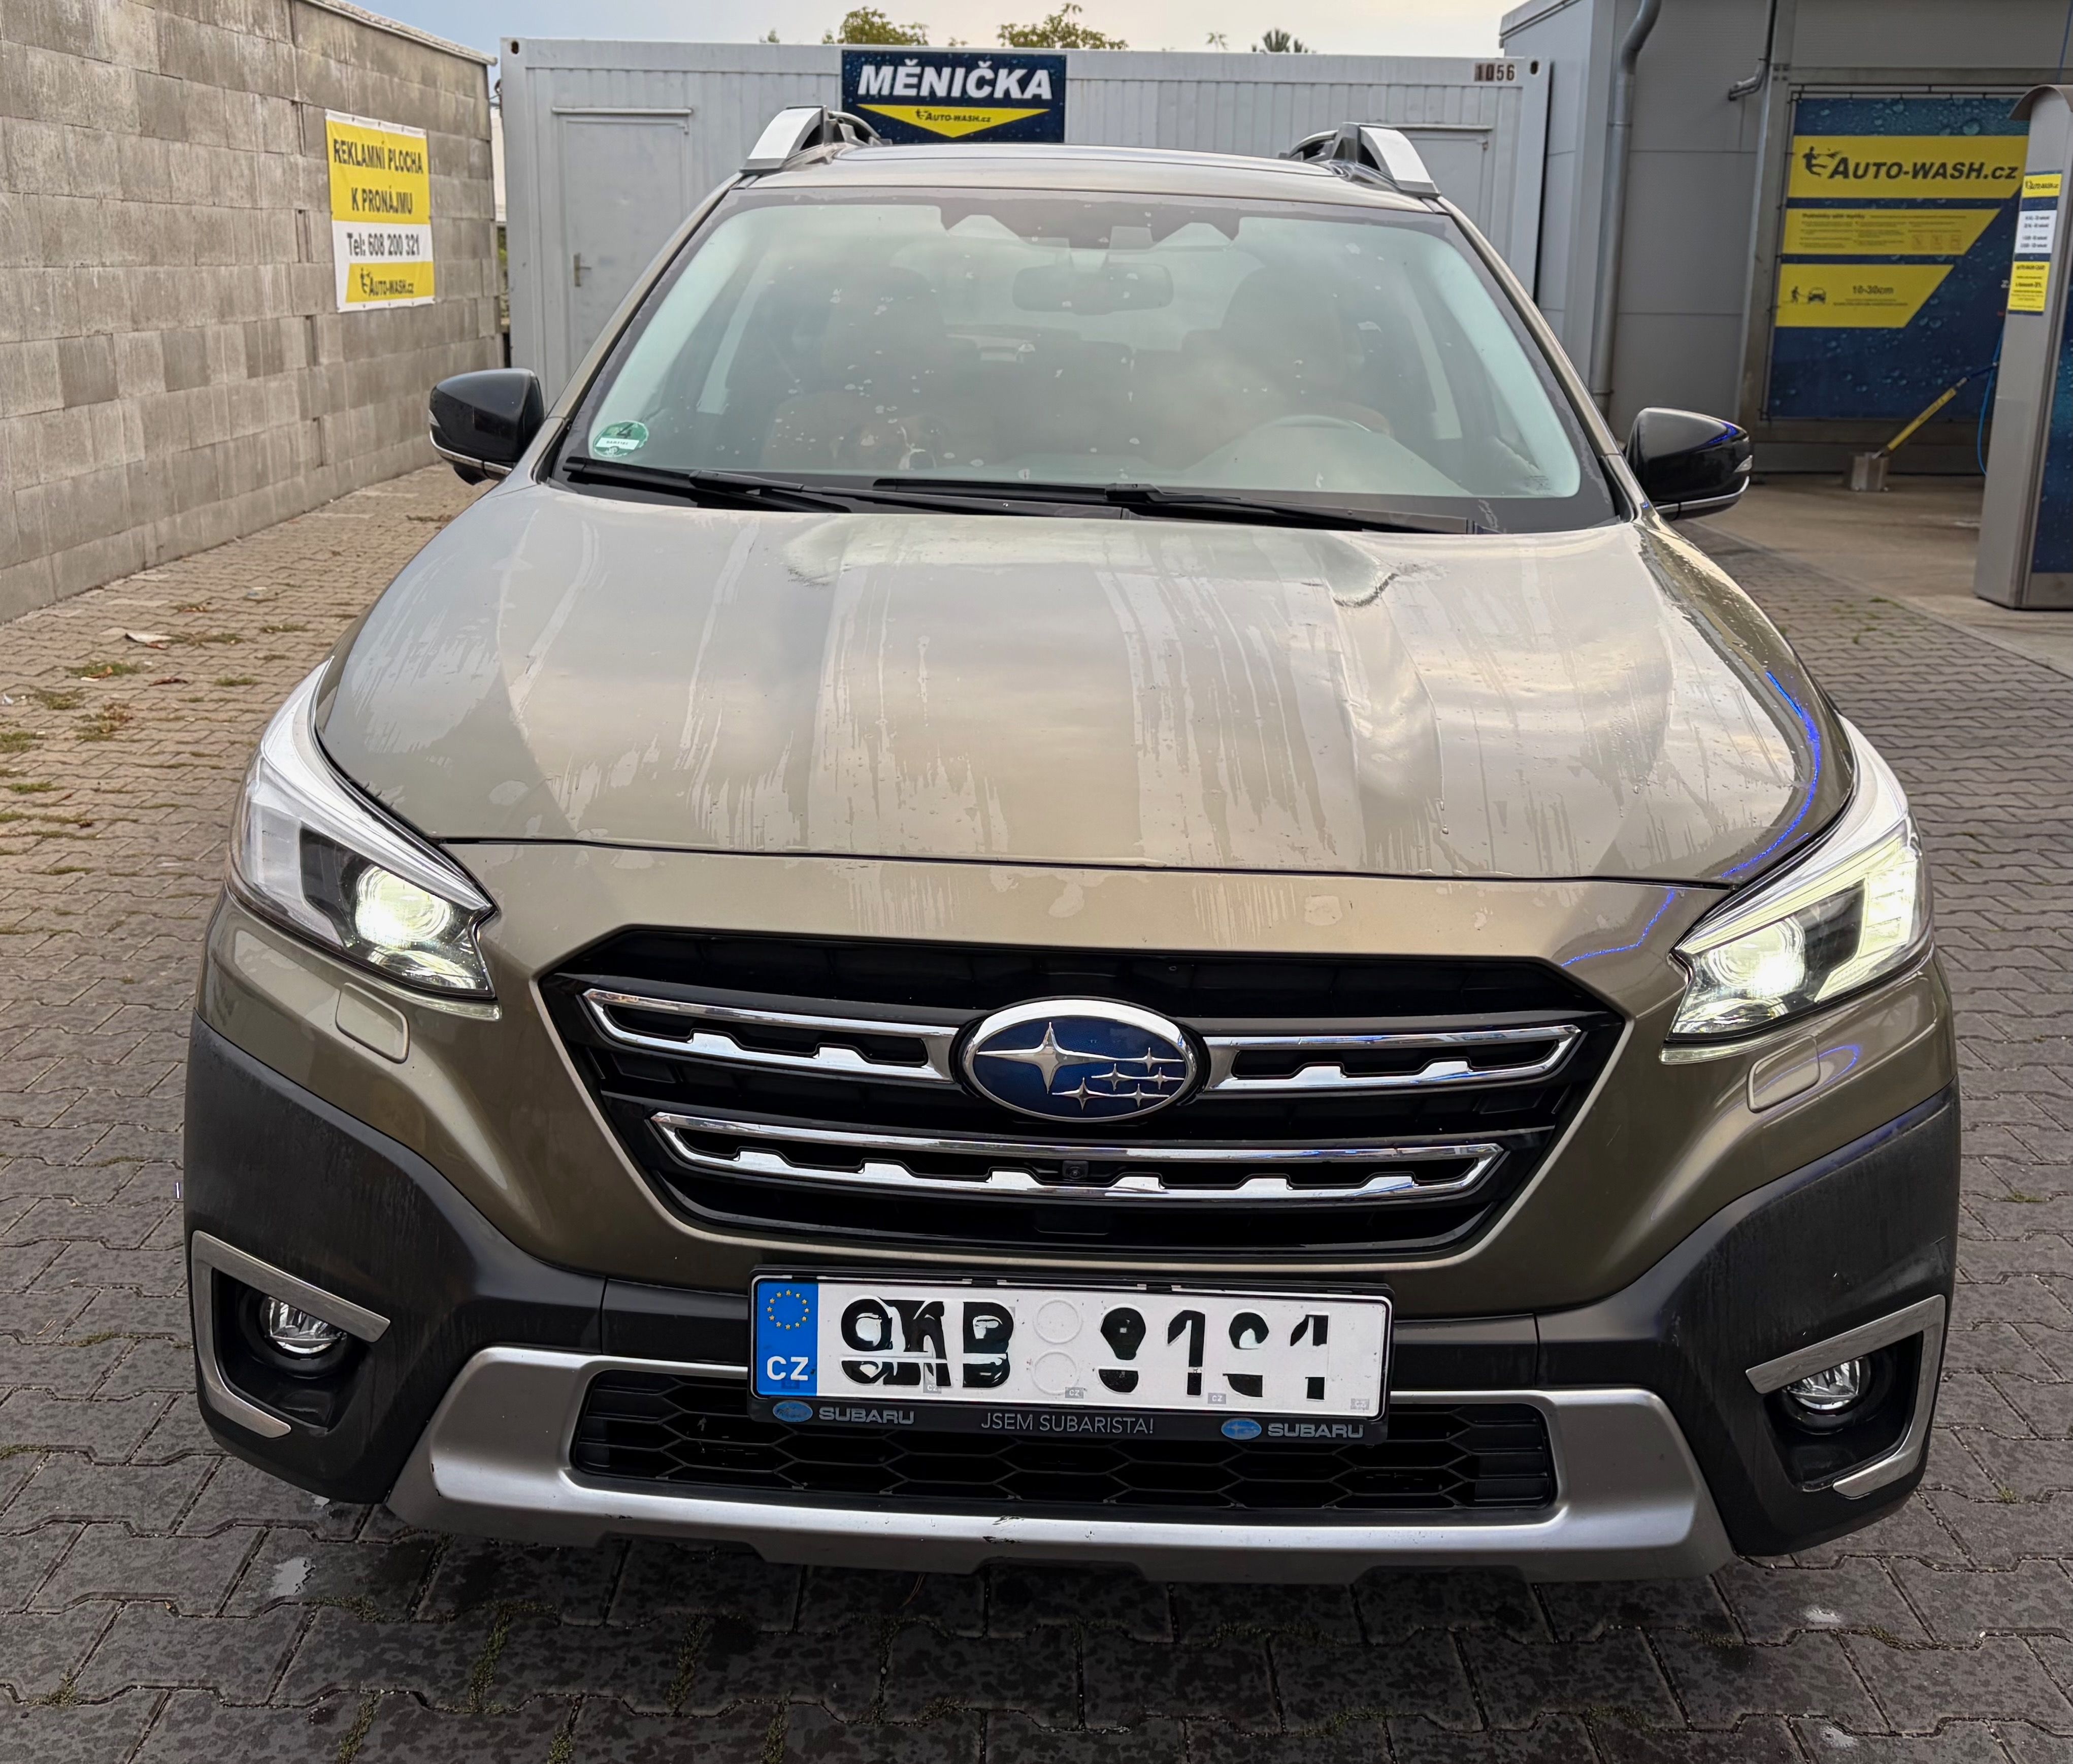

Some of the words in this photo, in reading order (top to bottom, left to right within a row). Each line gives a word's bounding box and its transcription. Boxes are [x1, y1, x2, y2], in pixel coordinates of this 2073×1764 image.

[858, 58, 1052, 100] MĚNIČKA
[1475, 63, 1515, 81] 1056
[334, 138, 386, 170] REKLAMNÍ
[388, 147, 423, 174] PLOCHA
[1828, 156, 2018, 180] AUTO-WASH.cz
[351, 187, 359, 211] K
[361, 185, 413, 215] PRONÁJMU
[347, 232, 366, 256] Tel:
[368, 233, 385, 256] 608
[387, 234, 404, 256] 200
[405, 234, 420, 255] 321
[616, 422, 634, 439] 4
[767, 1356, 809, 1381] CZ
[818, 1406, 914, 1424] SUBARU
[981, 1413, 1033, 1430] JSEM
[1039, 1415, 1154, 1434] SUBARISTA!
[1268, 1422, 1364, 1439] SUBARU
